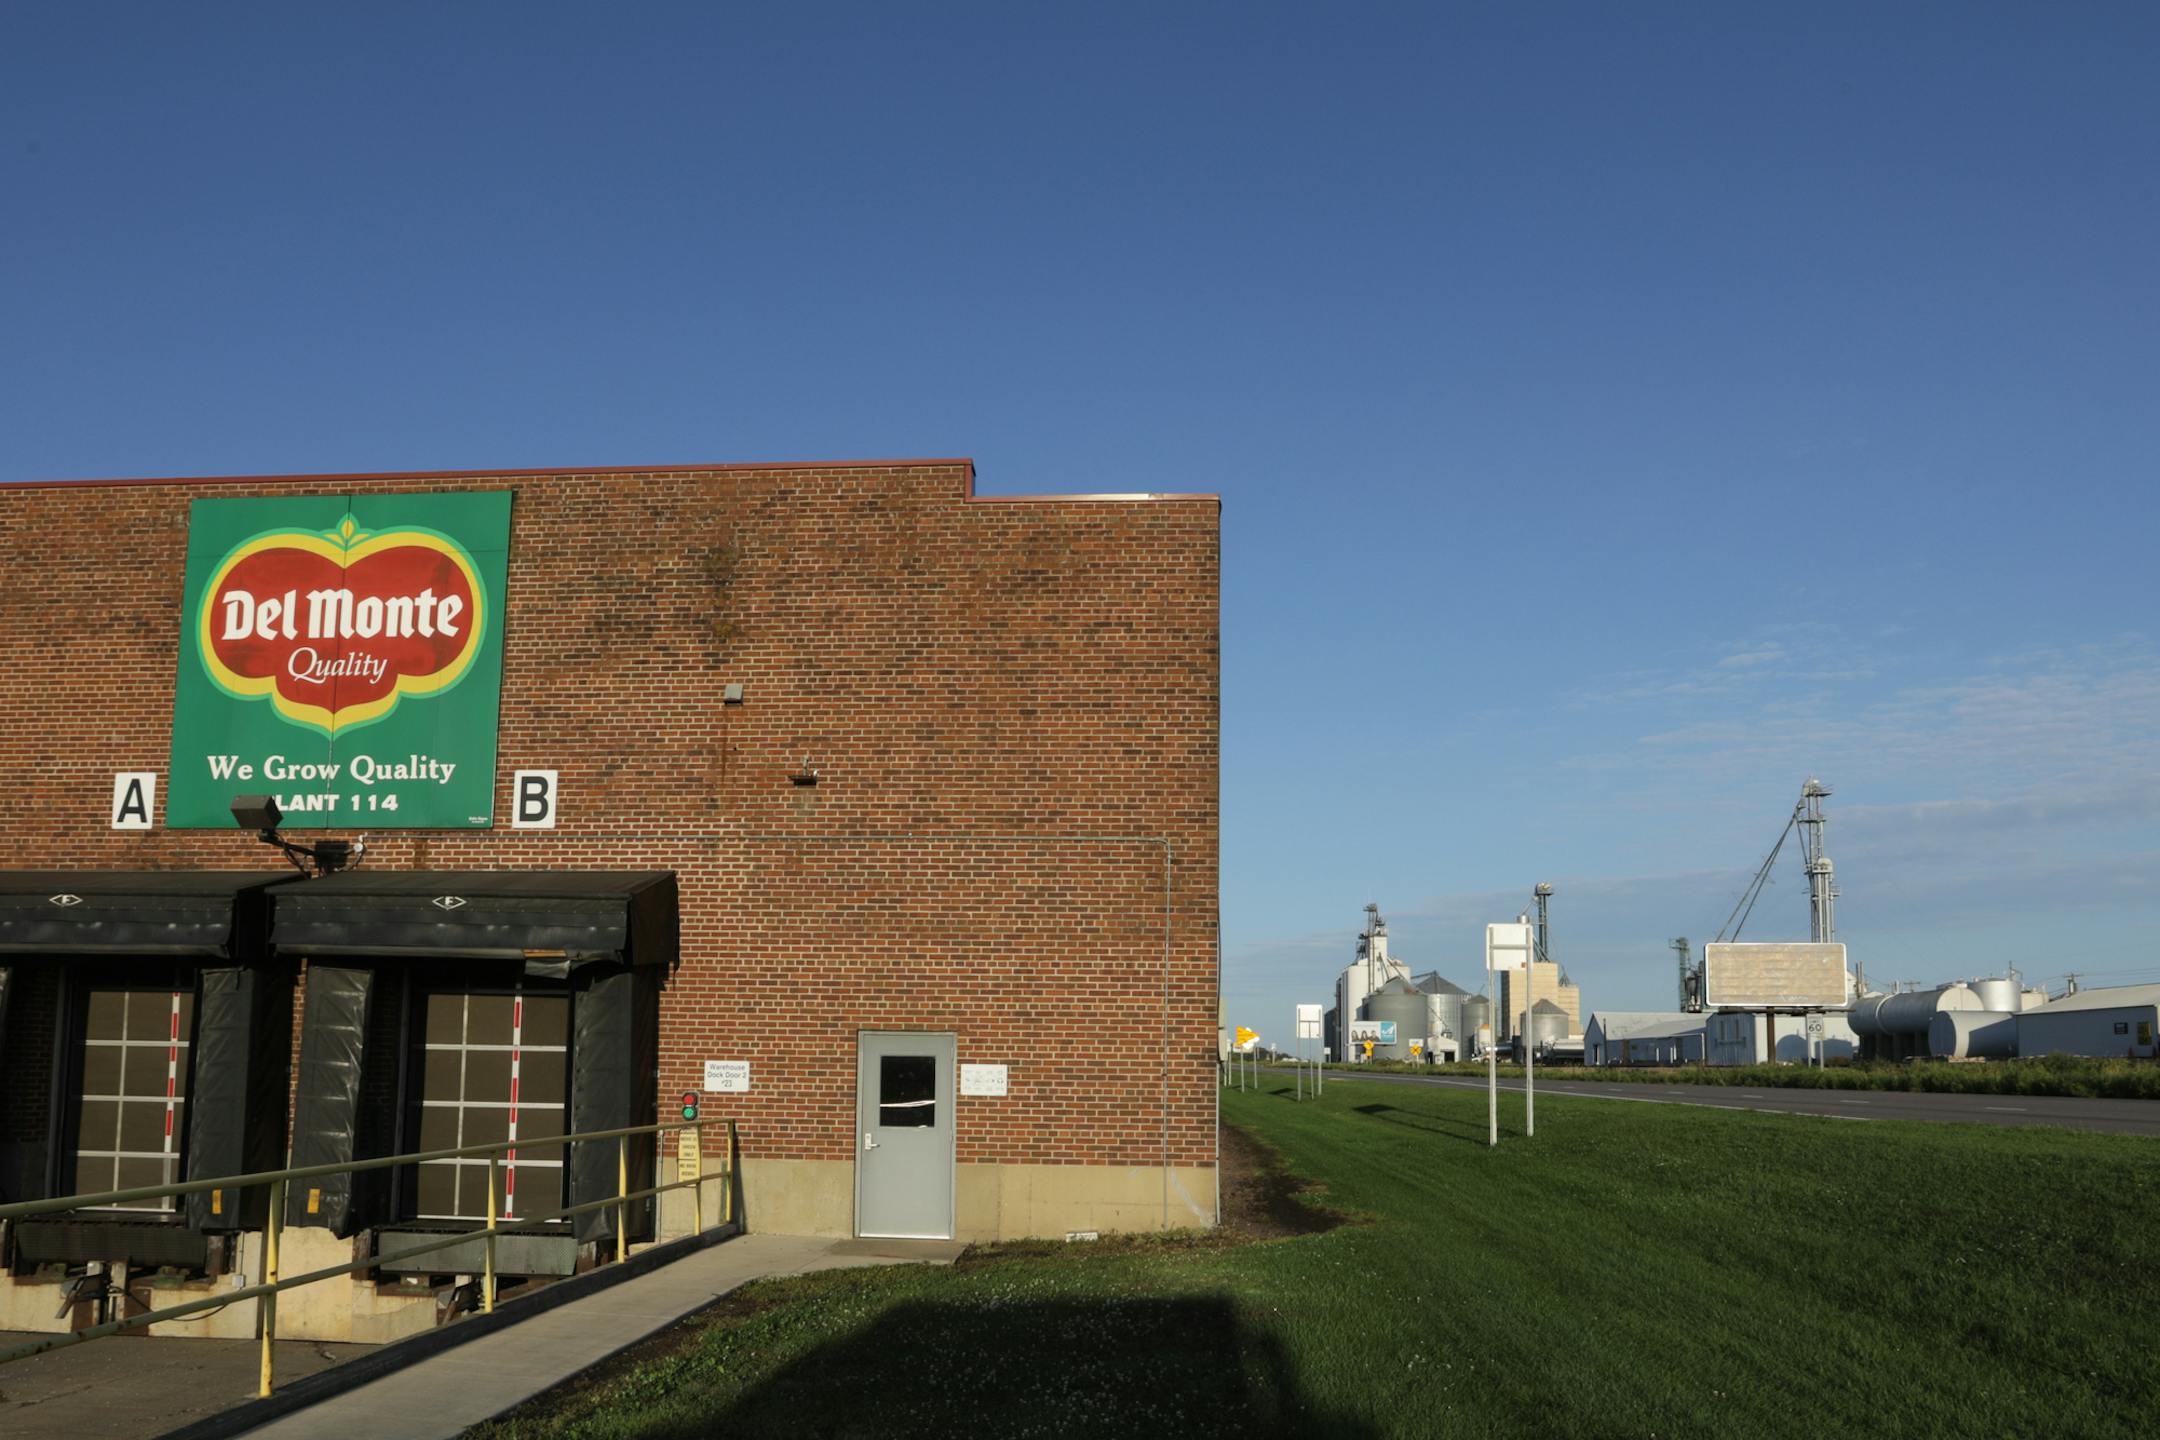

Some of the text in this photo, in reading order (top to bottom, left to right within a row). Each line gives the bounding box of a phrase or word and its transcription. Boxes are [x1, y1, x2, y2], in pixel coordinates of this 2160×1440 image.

[221, 587, 464, 641] Del Monte
[287, 647, 388, 684] Quality
[207, 755, 456, 784] We Grow Quality
[117, 778, 149, 824] A
[271, 794, 399, 812] LANT 114
[518, 776, 549, 822] B
[1808, 1023, 1822, 1032] 60
[709, 1063, 746, 1071] Warehouse
